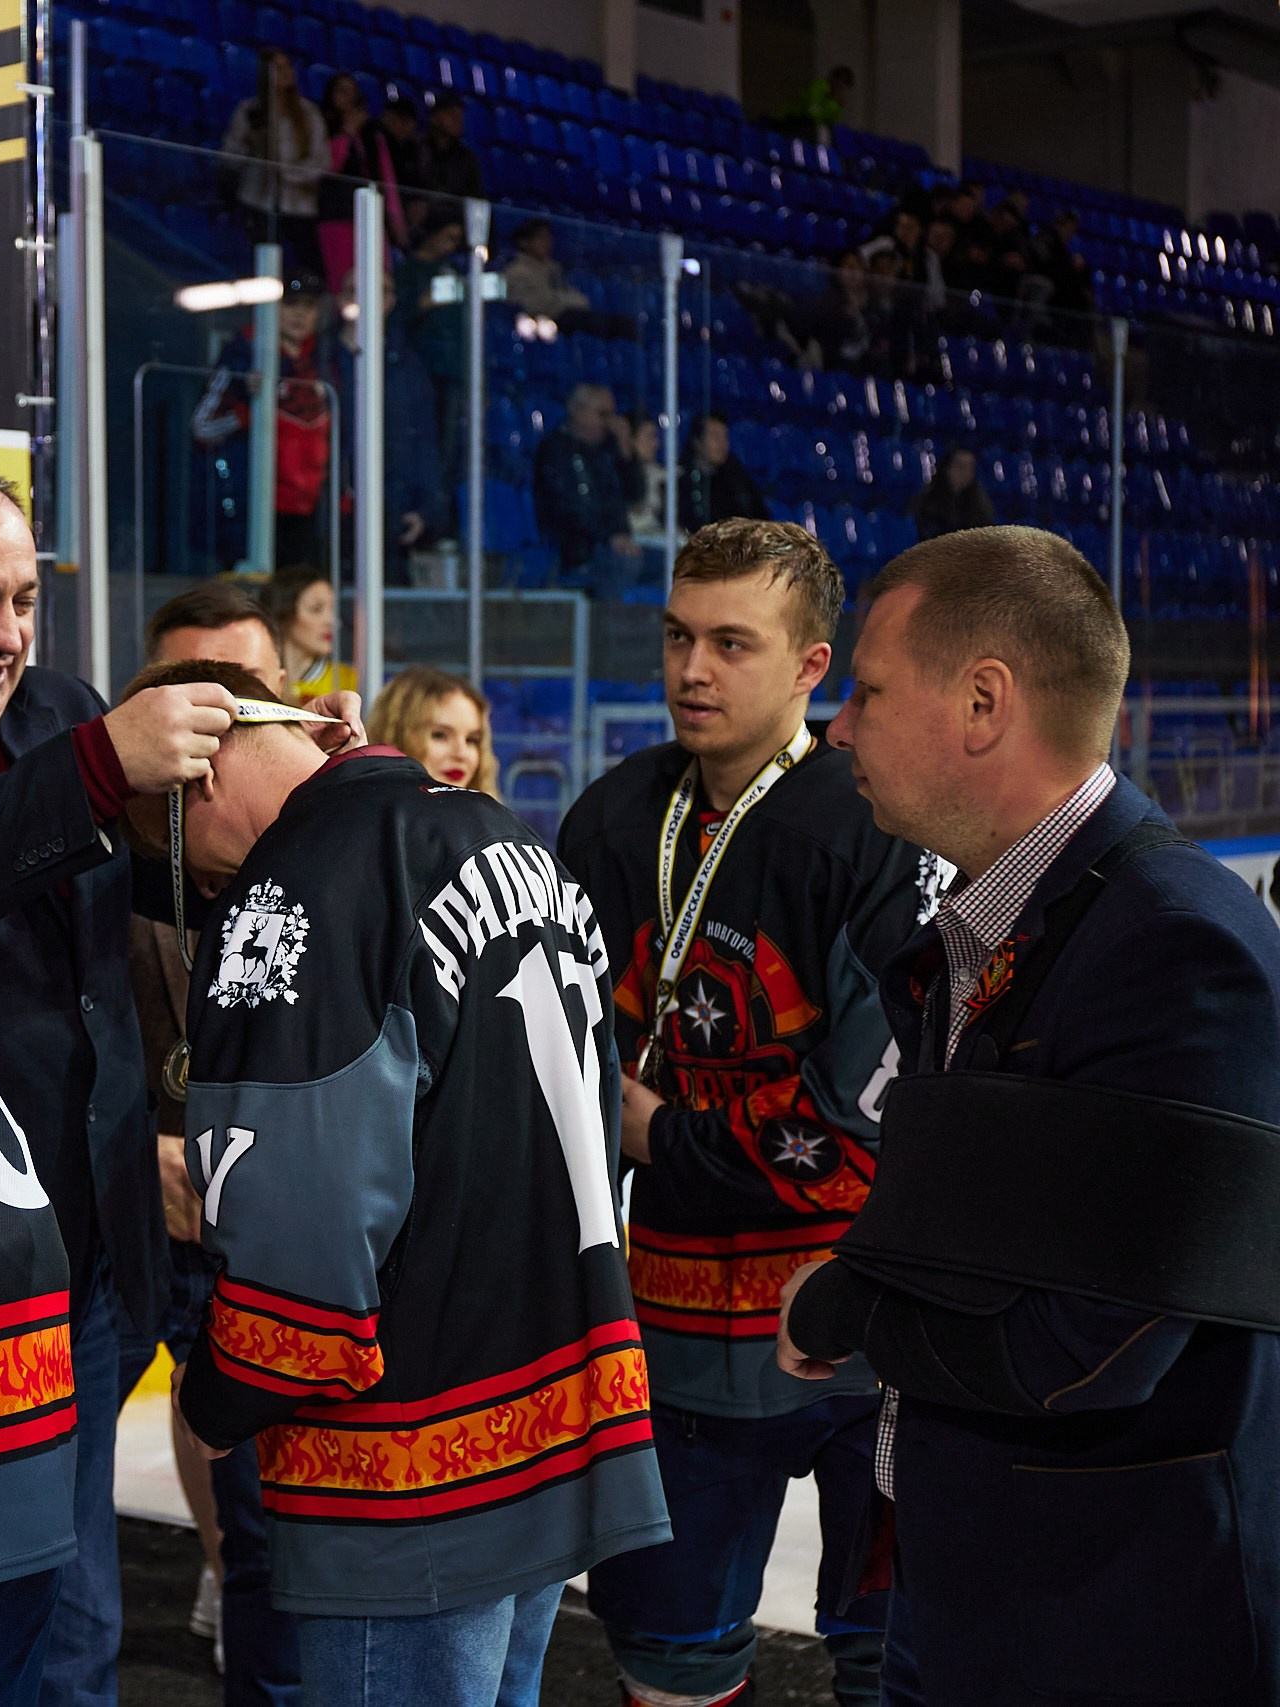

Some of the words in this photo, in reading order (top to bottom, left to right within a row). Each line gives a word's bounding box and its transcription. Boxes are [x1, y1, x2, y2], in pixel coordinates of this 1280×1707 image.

[171, 788, 181, 861] ХОККЕЙНА
[671, 880, 705, 960] ОФИЦЕРСКАЯ
[700, 810, 740, 879] ХОККЕЙНАЯ
[741, 784, 767, 809] ЛИГА
[495, 941, 619, 1255] 17
